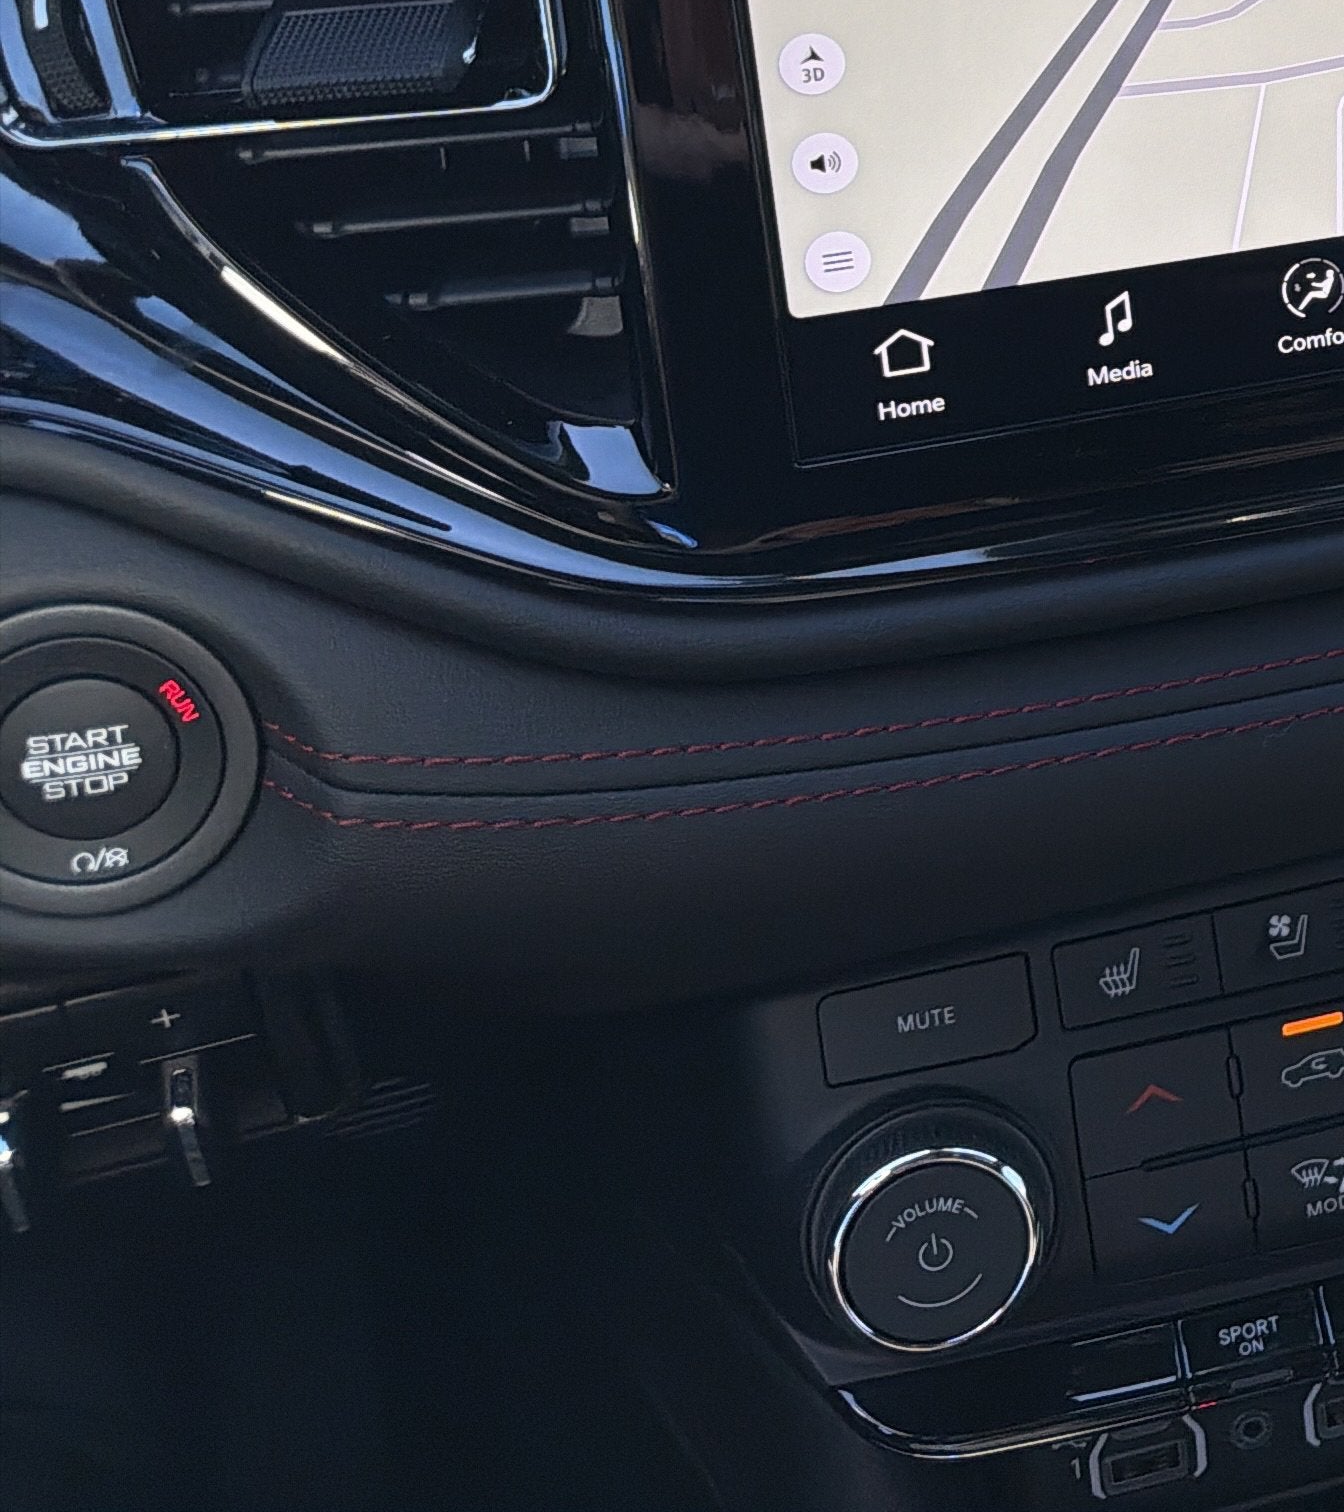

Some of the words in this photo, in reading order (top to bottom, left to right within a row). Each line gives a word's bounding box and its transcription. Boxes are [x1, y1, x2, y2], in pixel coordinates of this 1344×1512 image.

[802, 67, 825, 83] 3D
[1087, 358, 1154, 386] Media
[877, 394, 946, 421] Home
[159, 679, 200, 724] RUN
[26, 724, 129, 754] START
[20, 745, 142, 781] ENGINE
[43, 771, 129, 800] STOP
[897, 1006, 957, 1034] MUTE
[891, 1197, 965, 1231] VOLUME
[1218, 1315, 1280, 1347] SPORT
[1238, 1337, 1266, 1357] ON
